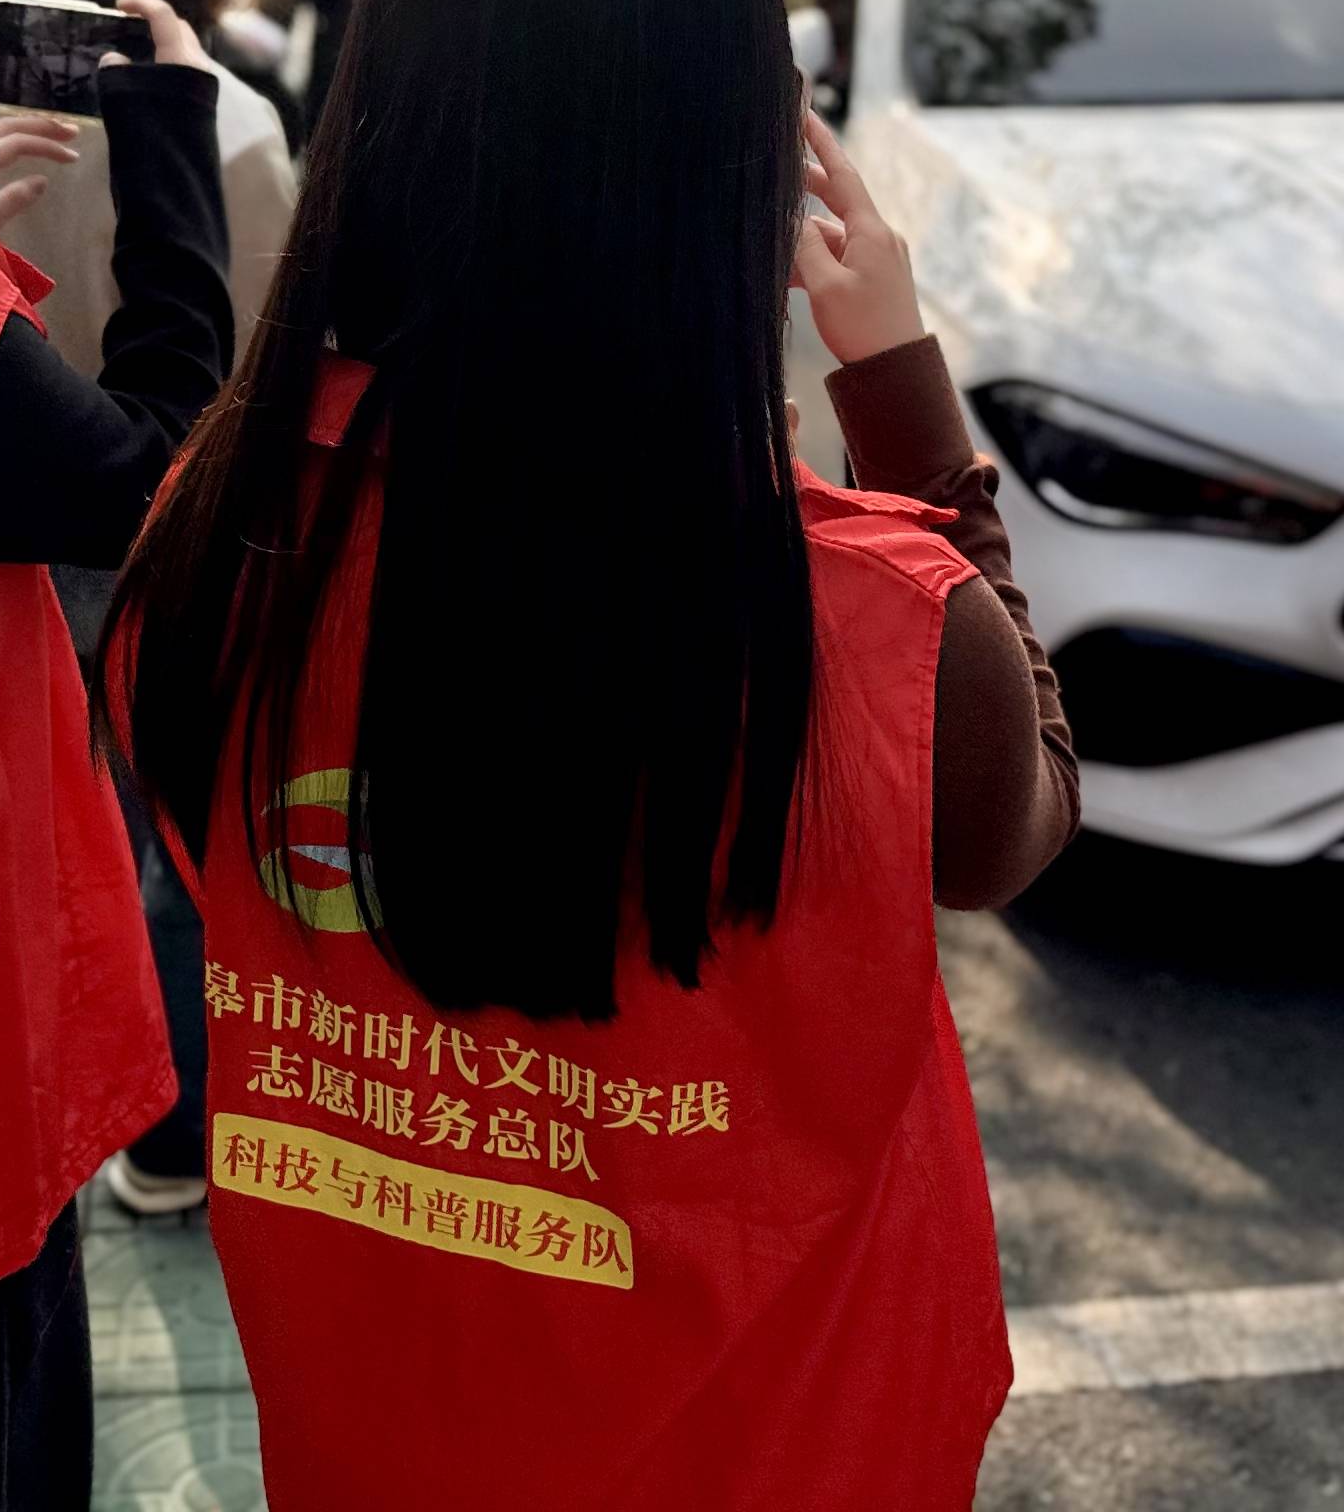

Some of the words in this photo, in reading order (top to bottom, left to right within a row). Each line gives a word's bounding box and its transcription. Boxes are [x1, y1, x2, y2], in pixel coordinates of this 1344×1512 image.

[205, 960, 729, 1136] 皋市新时代文明实践
[246, 1045, 599, 1181] 志愿服务总队
[223, 1132, 629, 1274] 科技与科普服务队
